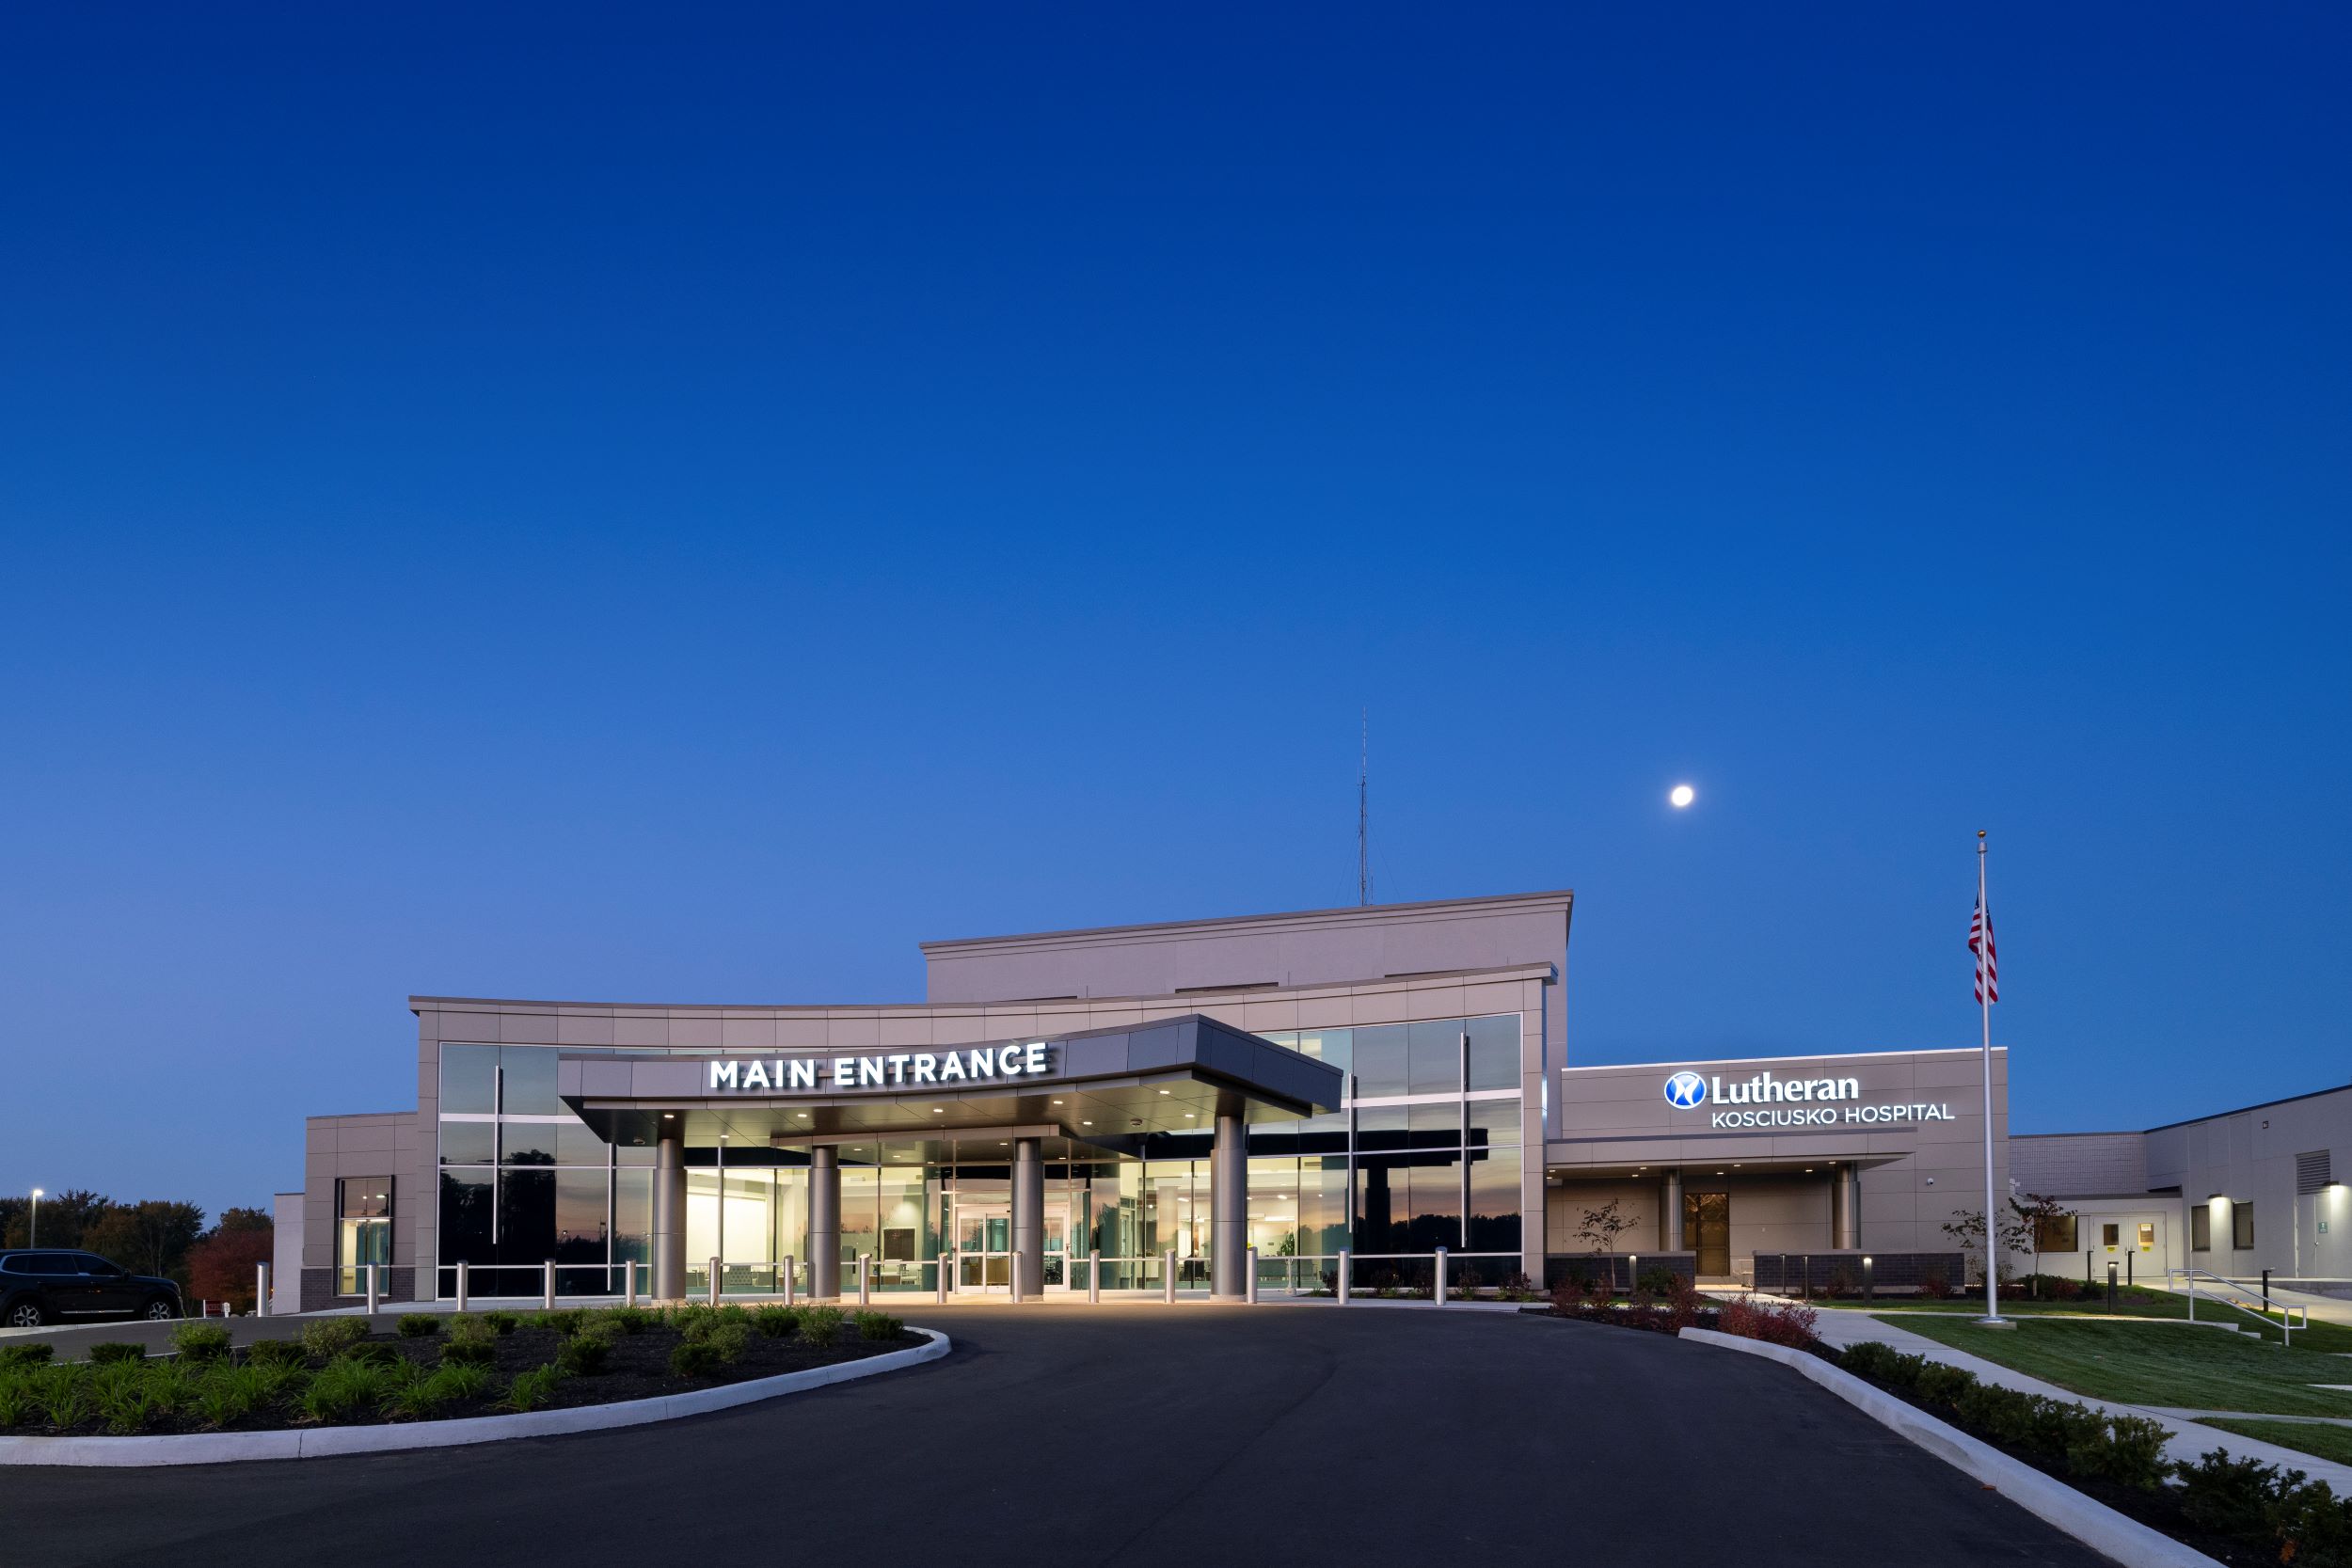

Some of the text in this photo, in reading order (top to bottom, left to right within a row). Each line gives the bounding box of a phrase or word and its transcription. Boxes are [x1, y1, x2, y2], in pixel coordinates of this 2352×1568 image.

[710, 1042, 1046, 1088] MAIN ENTRANCE
[1711, 1071, 1859, 1104] Lutheran
[1711, 1103, 1956, 1128] KOSCIUSKO HOSPITAL
